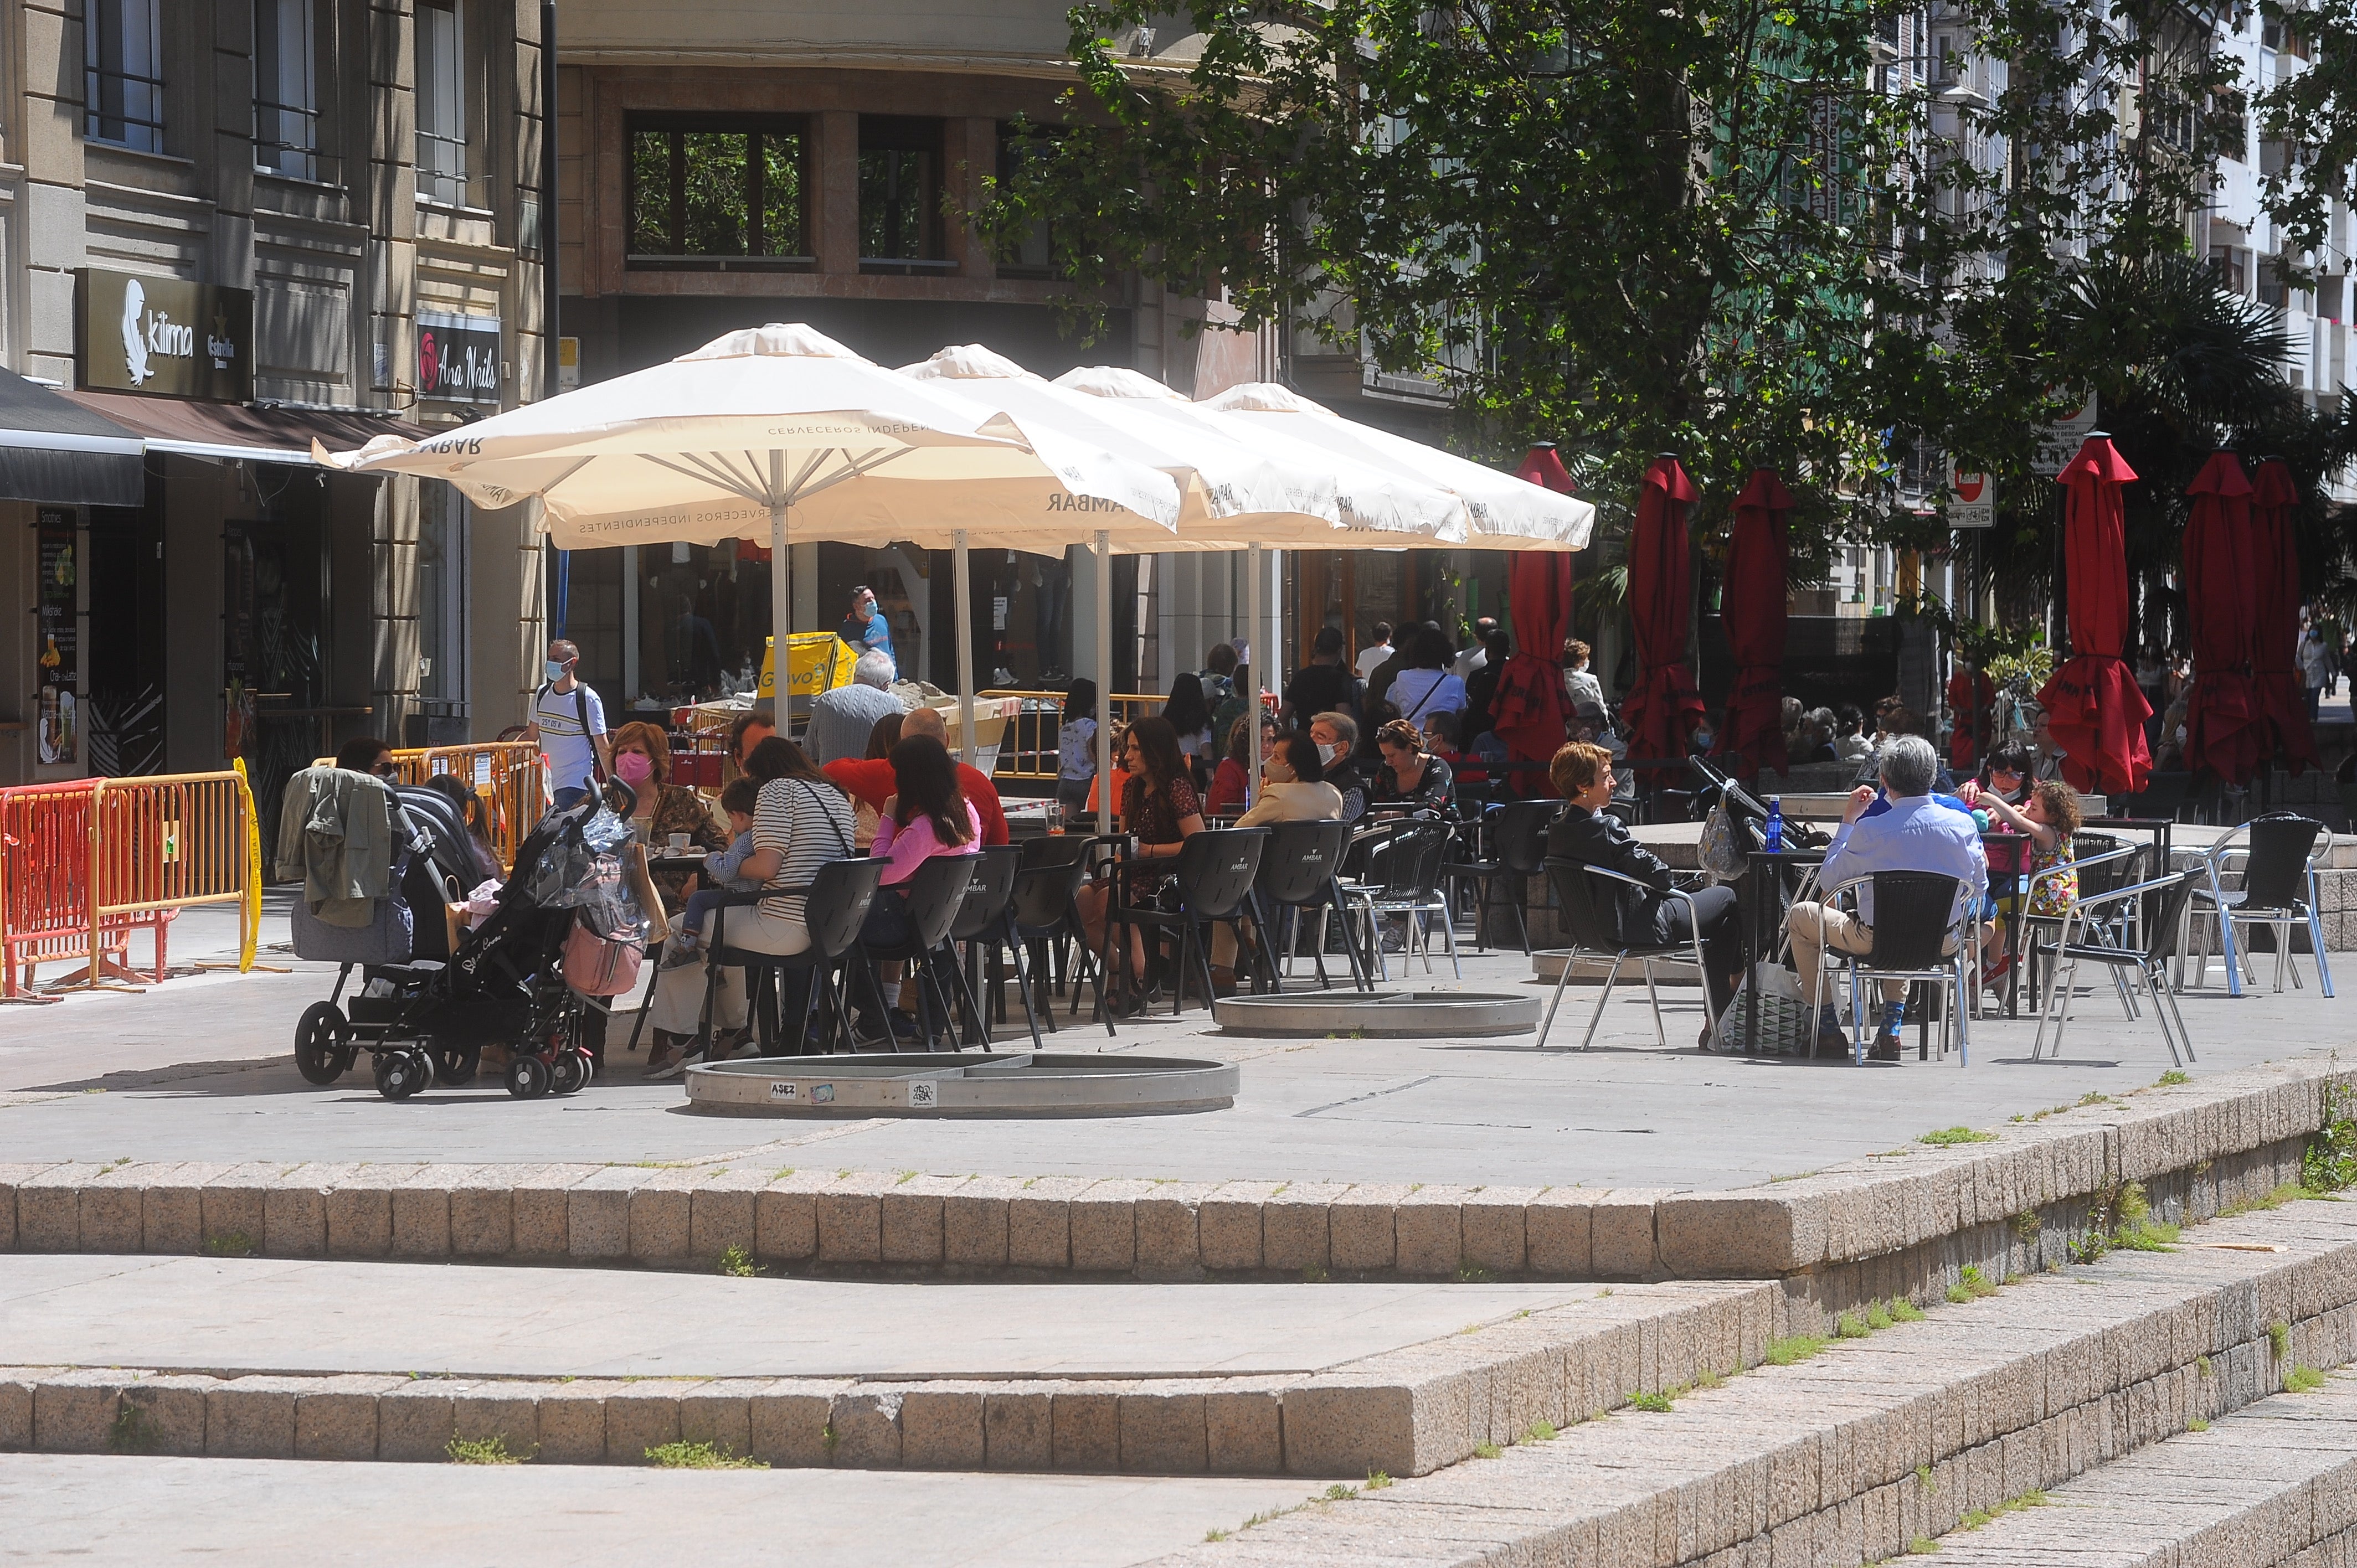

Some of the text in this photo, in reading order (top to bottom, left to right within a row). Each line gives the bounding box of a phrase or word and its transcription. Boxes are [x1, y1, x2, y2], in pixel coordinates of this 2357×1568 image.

[147, 310, 193, 357] kilima
[438, 343, 463, 387] Ana
[466, 345, 496, 390] Nails
[762, 672, 813, 687] GVO
